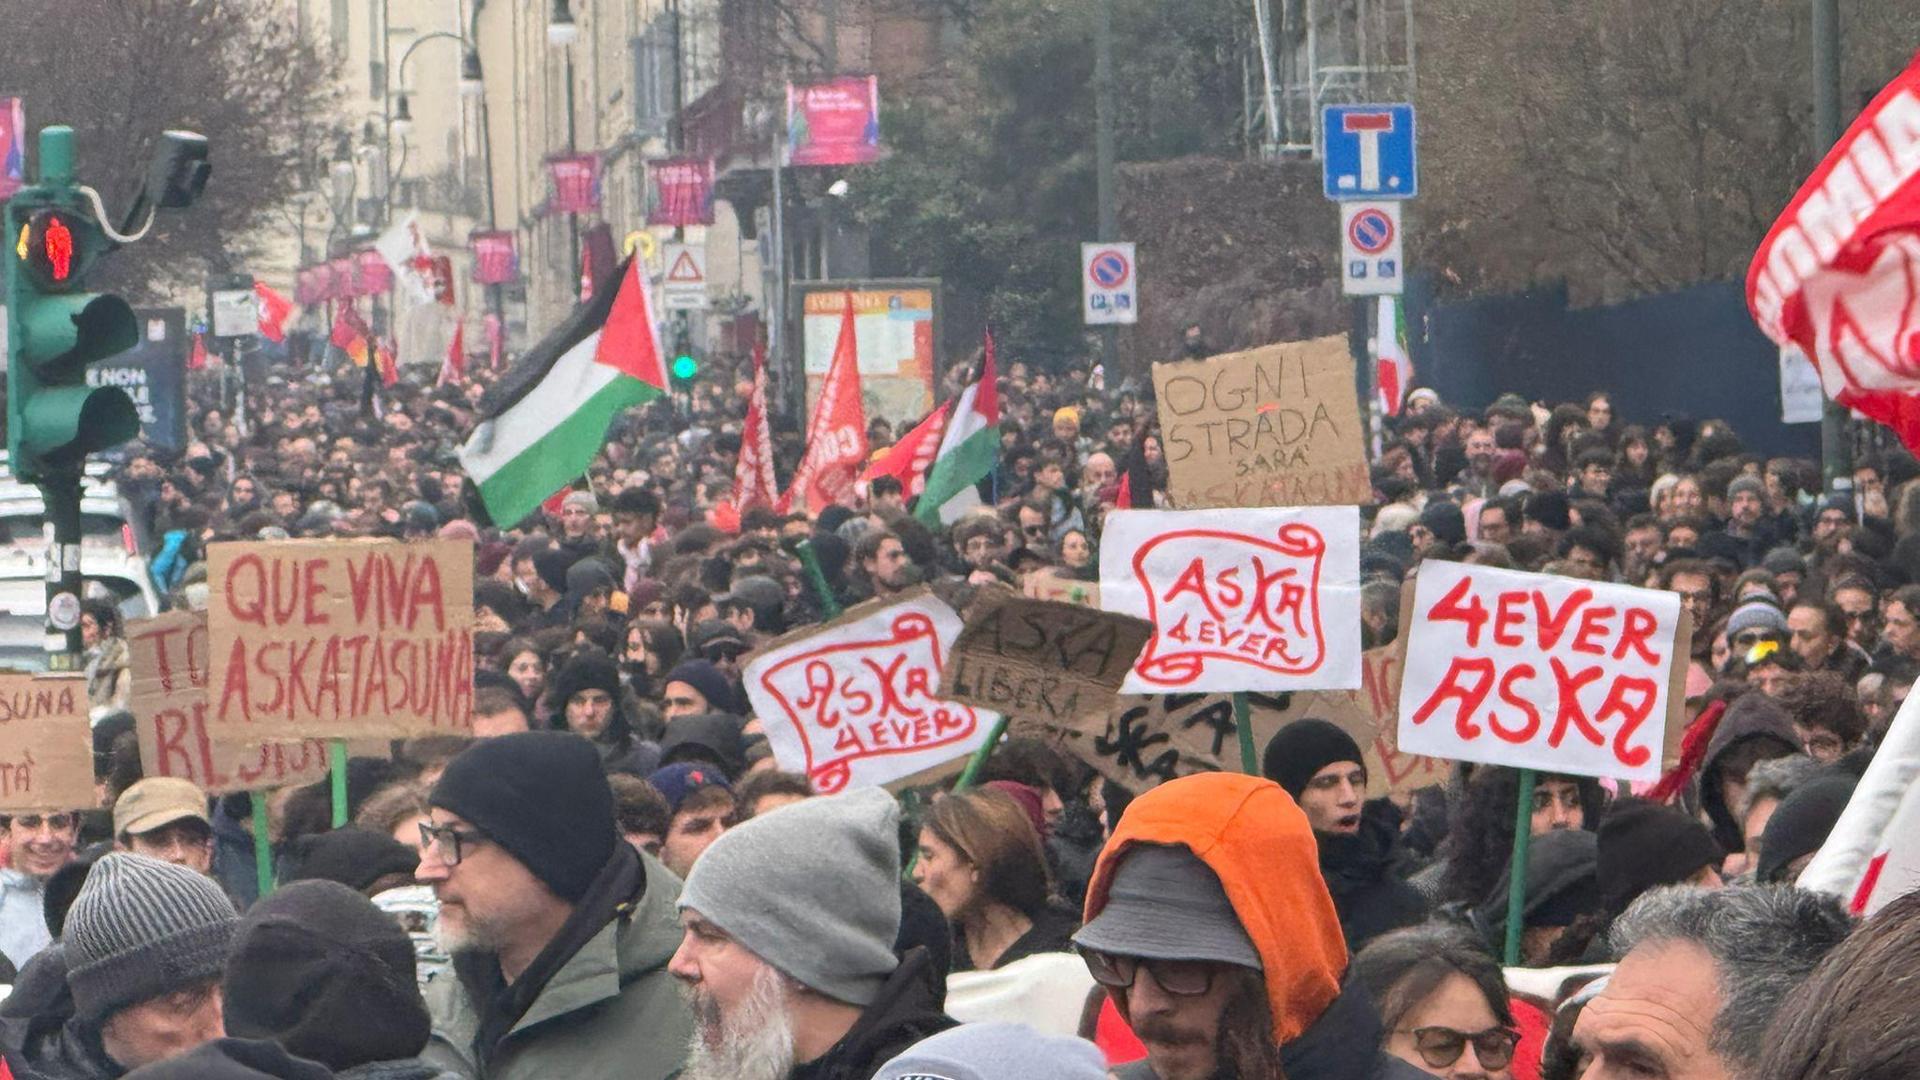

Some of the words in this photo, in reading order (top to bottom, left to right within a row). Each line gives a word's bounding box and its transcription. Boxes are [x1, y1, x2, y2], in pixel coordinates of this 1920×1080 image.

[1165, 355, 1308, 416] OGNI
[1169, 402, 1340, 462] STRADA
[225, 553, 330, 627] QUE
[347, 551, 446, 633] VIVA
[1163, 555, 1308, 638] ASKA
[1427, 576, 1661, 666] 4EVER
[960, 606, 1119, 678] ASKA
[1168, 612, 1303, 665] 4EVER
[218, 625, 473, 728] ASKATASUNA
[797, 653, 937, 728] ASKA
[1412, 656, 1658, 767] ASKA
[833, 709, 963, 753] 4EVER
